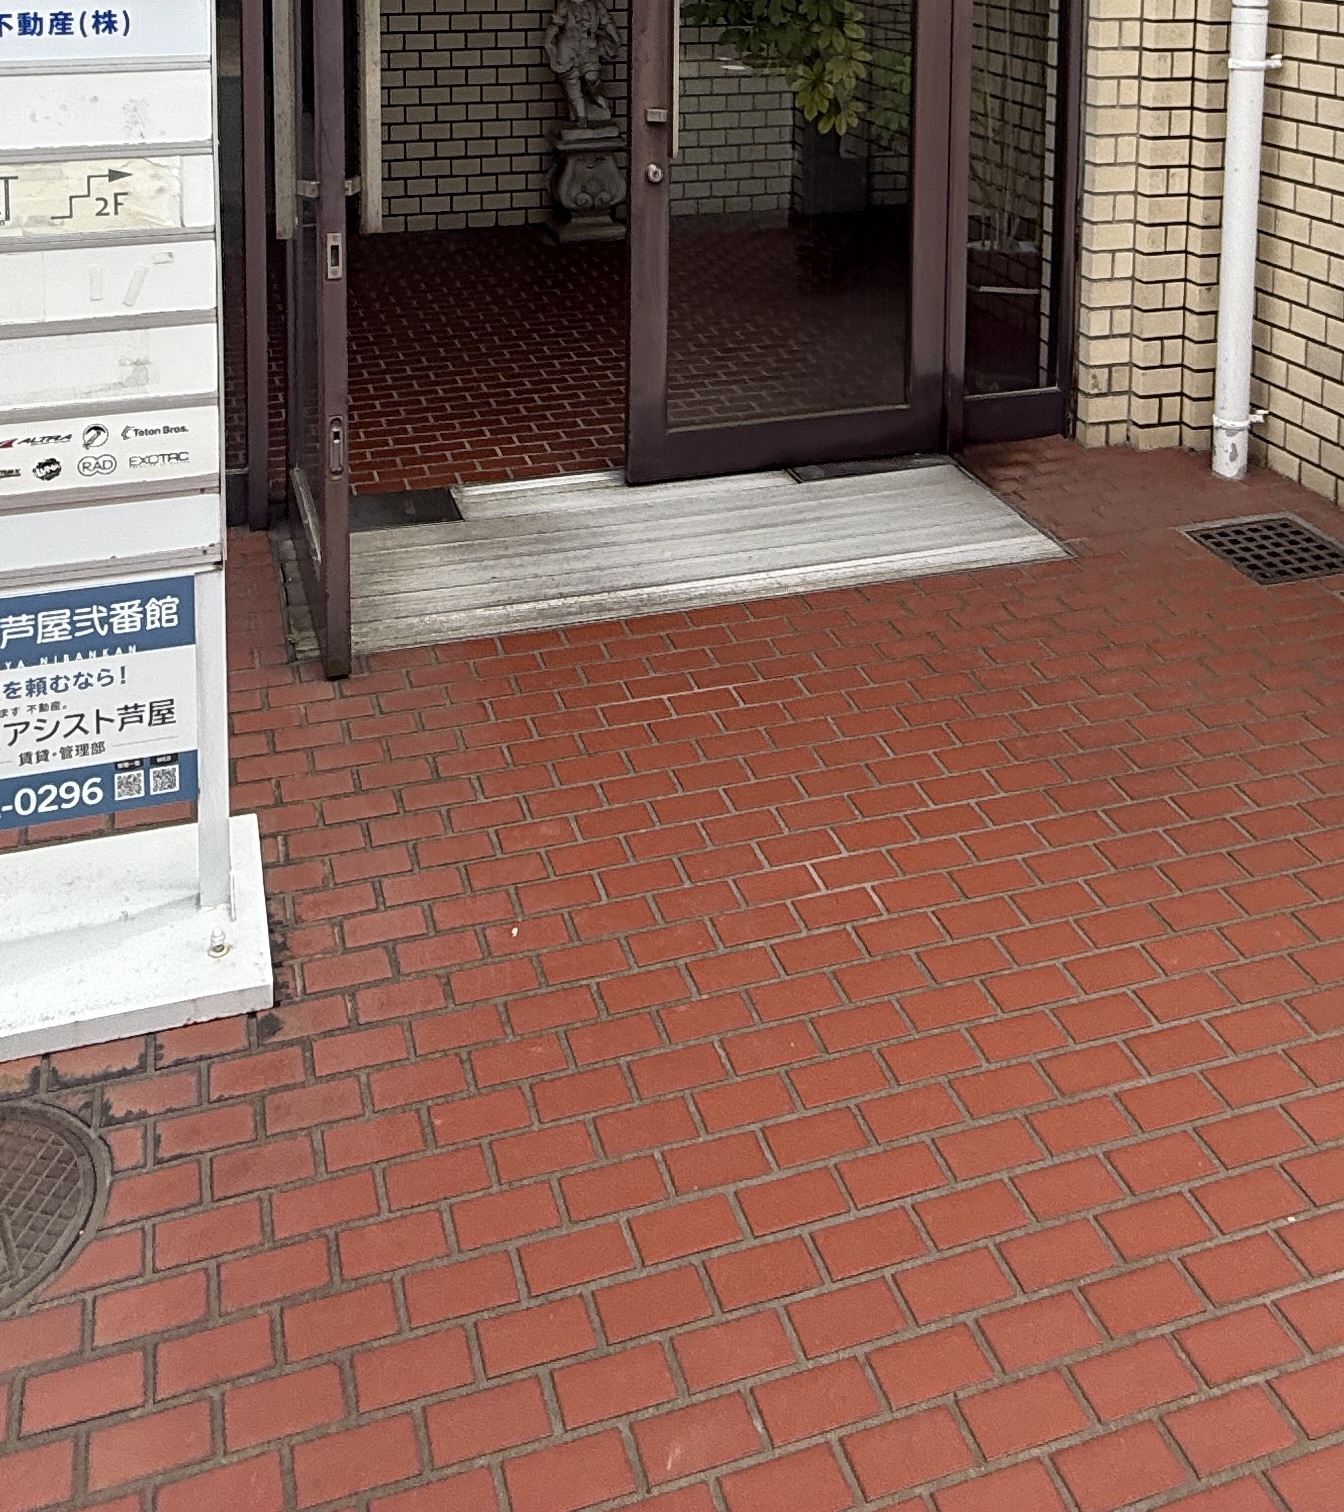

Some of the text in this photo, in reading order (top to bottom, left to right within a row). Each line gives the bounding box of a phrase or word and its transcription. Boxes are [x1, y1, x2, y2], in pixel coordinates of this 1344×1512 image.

[95, 191, 129, 217] 2F
[133, 427, 161, 437] Teton
[82, 459, 113, 472] RAD
[40, 644, 138, 666] NIBANKAN
